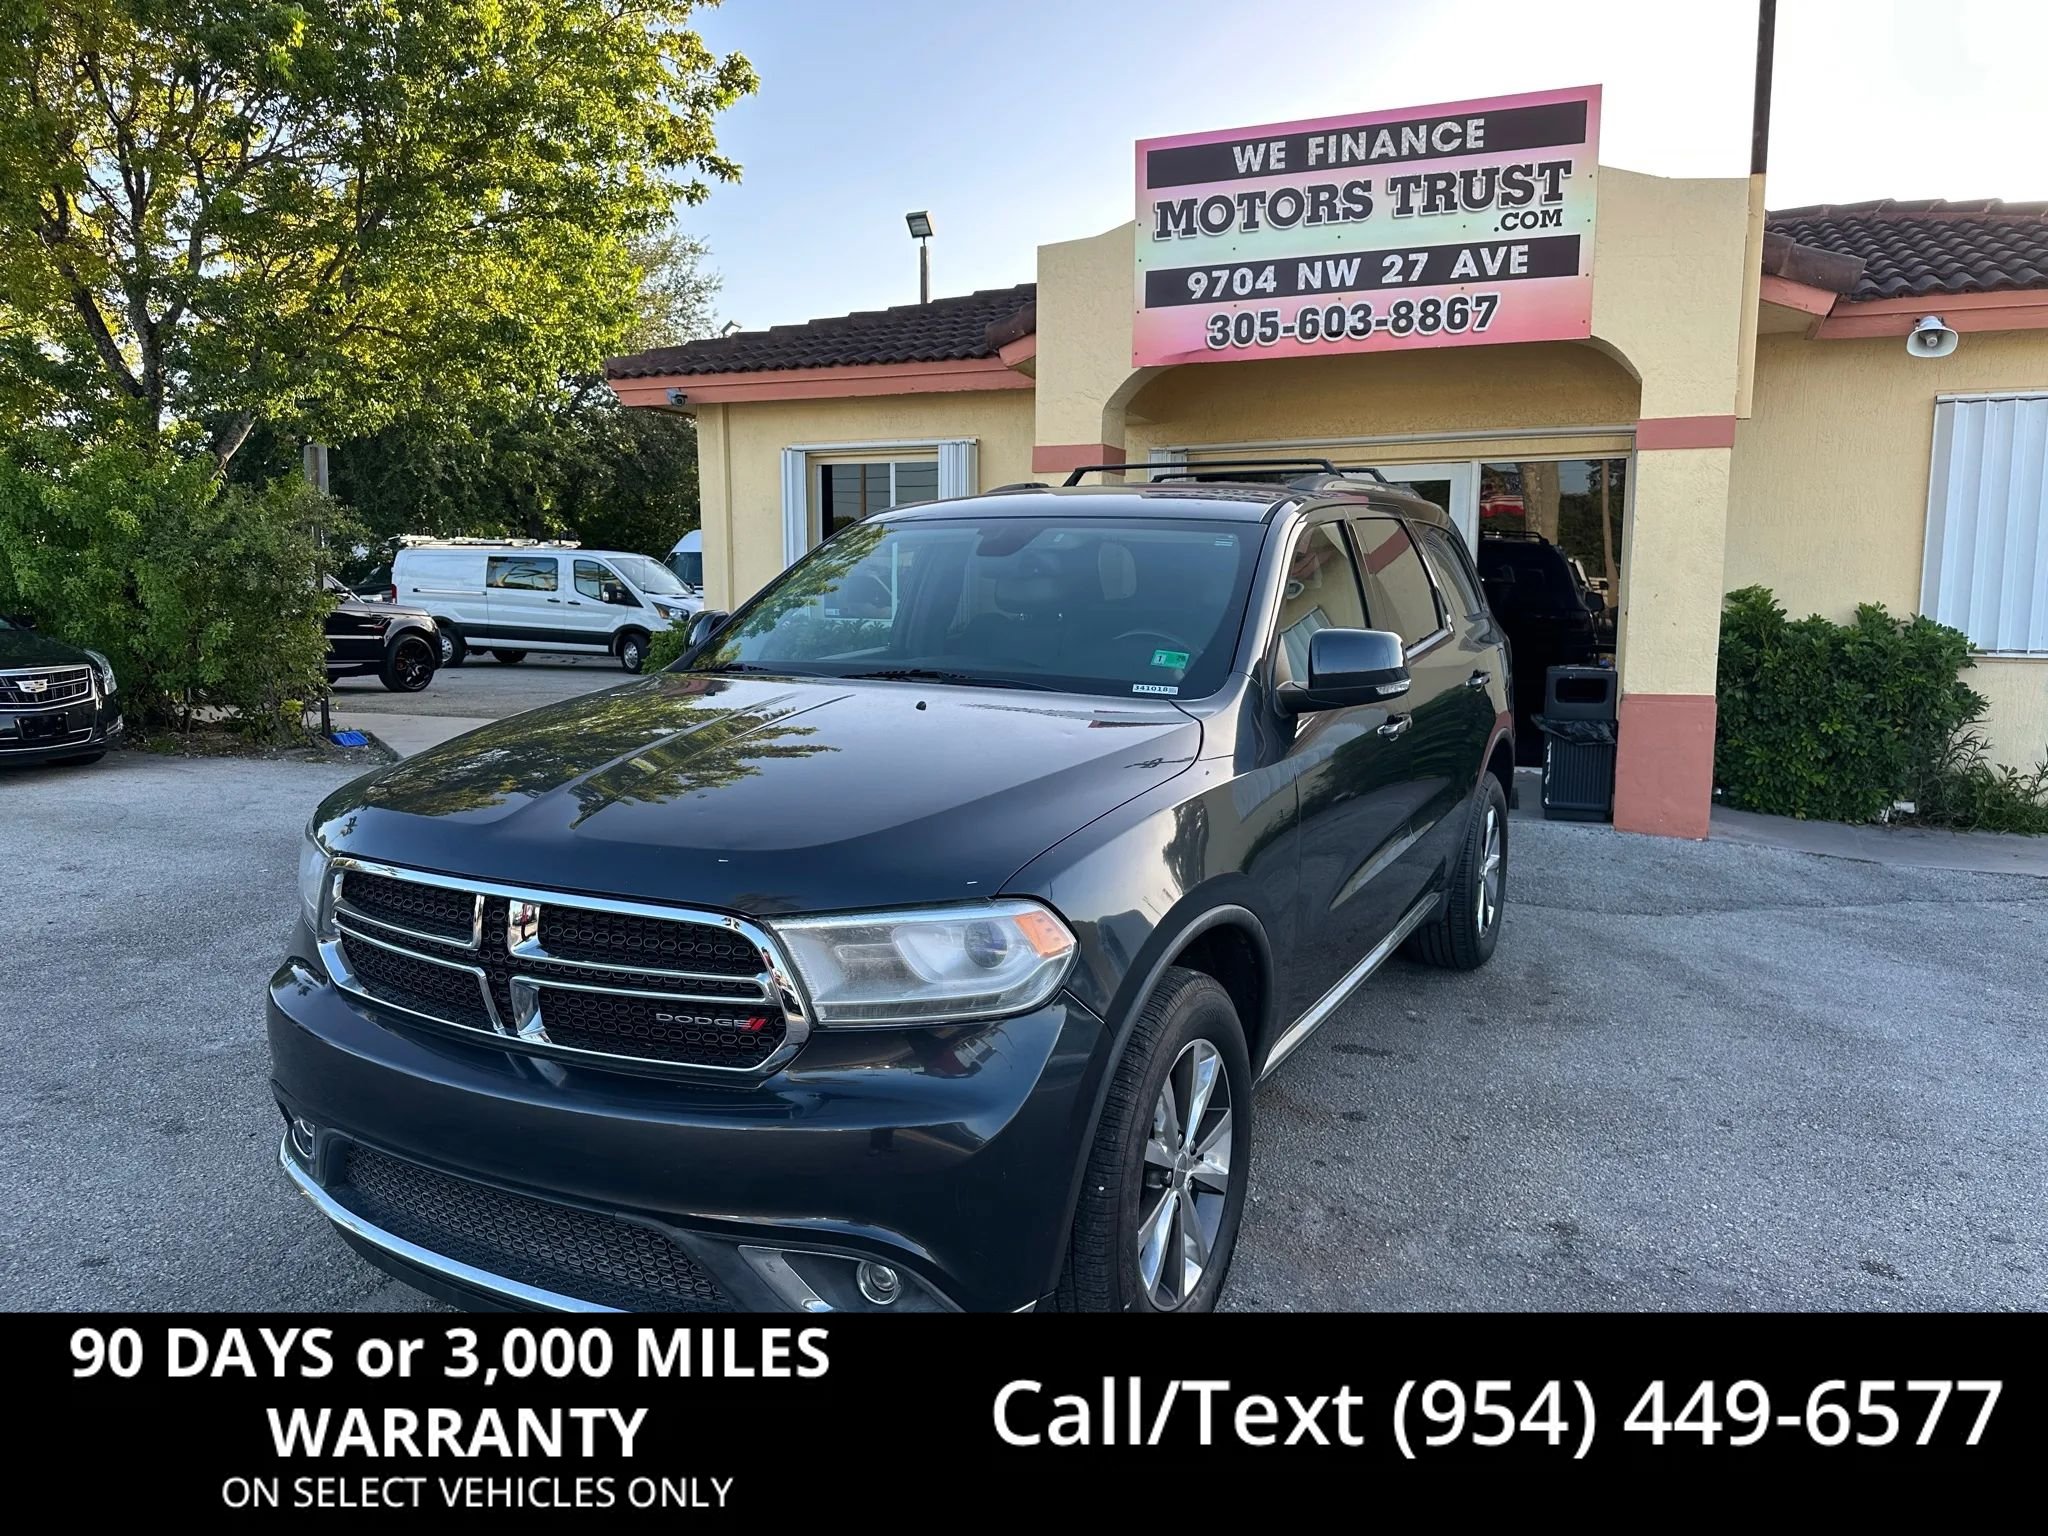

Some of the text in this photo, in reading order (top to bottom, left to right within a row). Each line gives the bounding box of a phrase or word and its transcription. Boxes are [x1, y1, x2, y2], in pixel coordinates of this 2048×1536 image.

[1232, 118, 1485, 175] WE FINANCE
[1154, 160, 1572, 240] MOTORS TRUST
[1493, 208, 1563, 233] .COM
[1187, 245, 1529, 300] 9704 NW 27 AVE
[1207, 294, 1499, 349] 305-603-8867
[655, 1013, 752, 1028] DODGE
